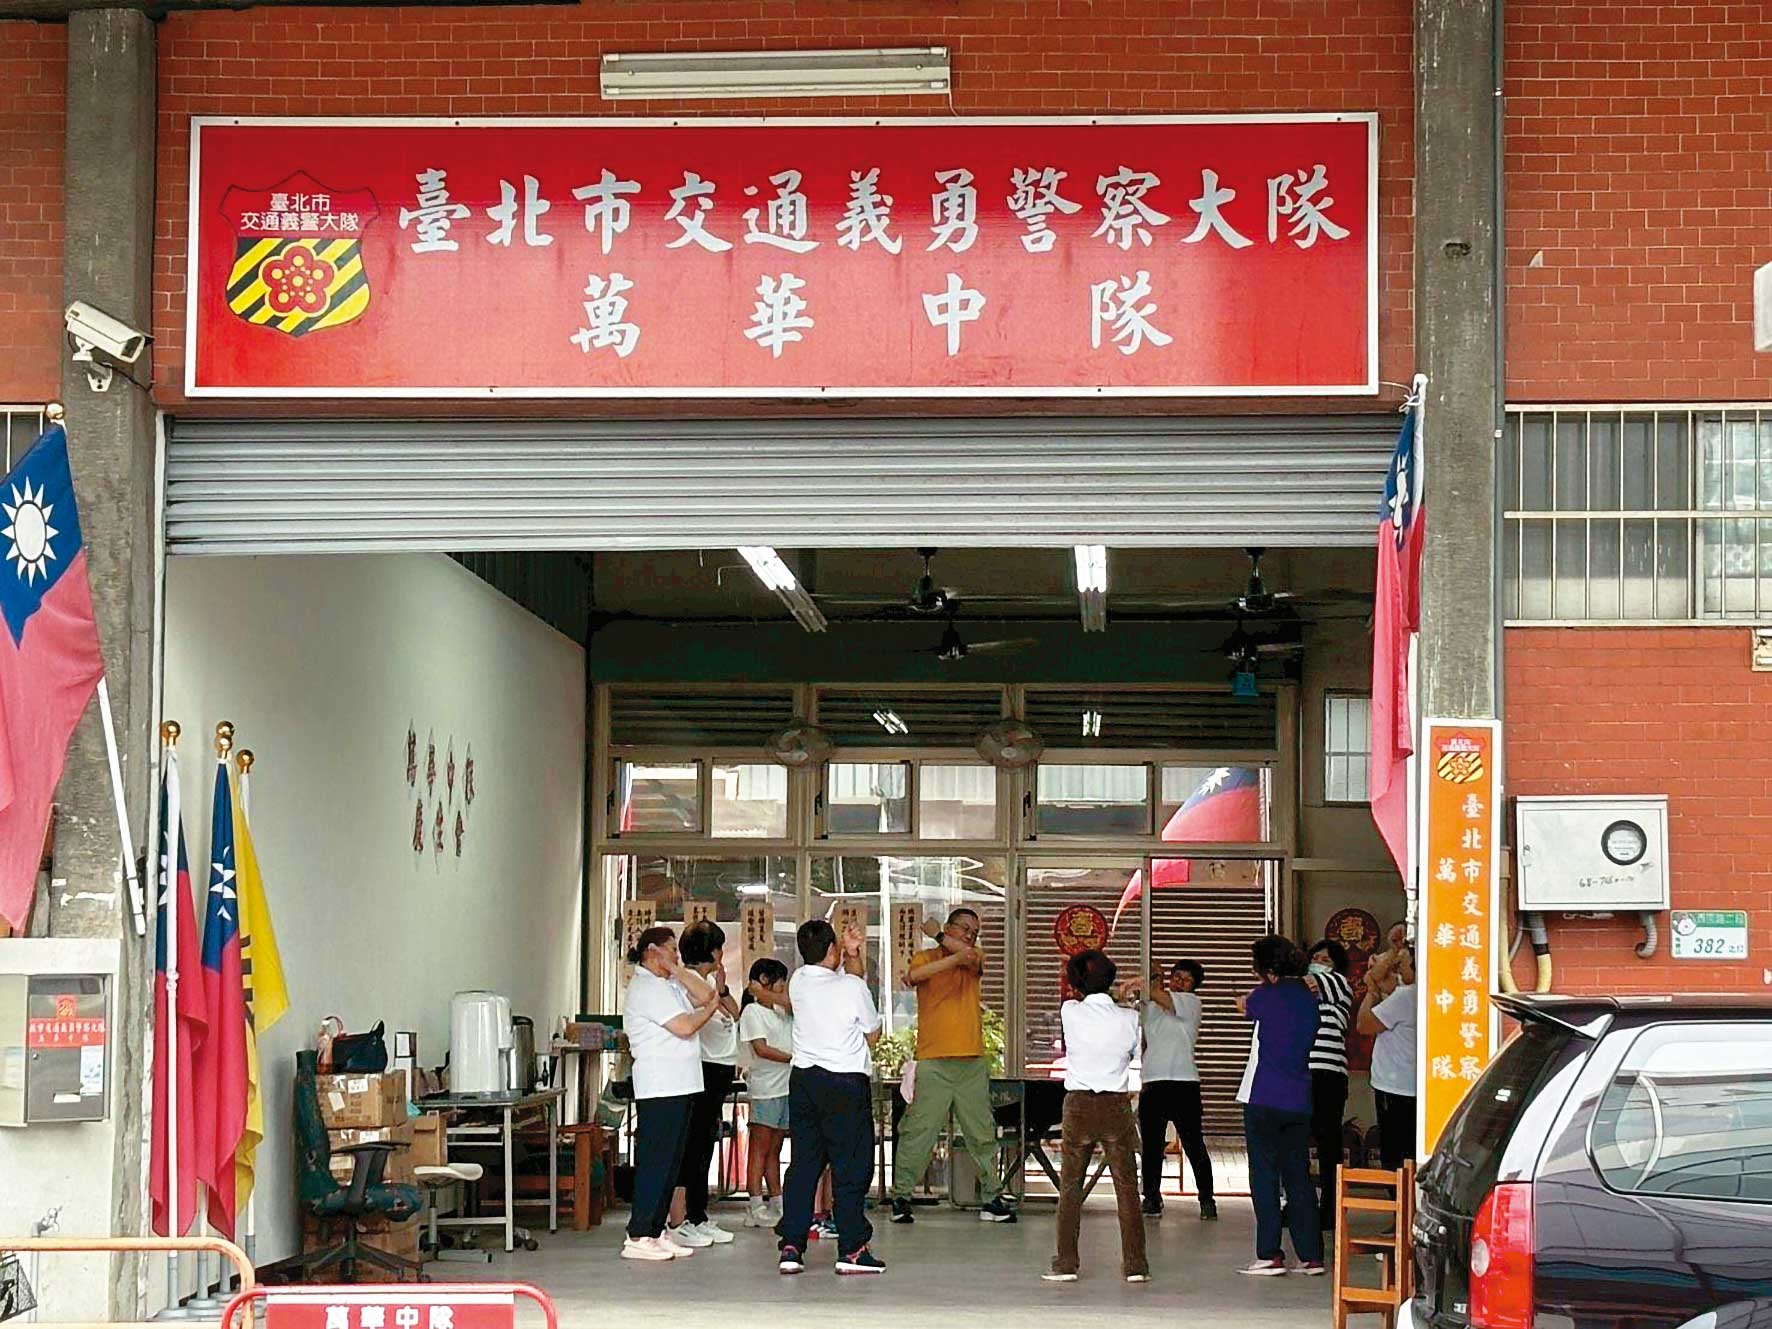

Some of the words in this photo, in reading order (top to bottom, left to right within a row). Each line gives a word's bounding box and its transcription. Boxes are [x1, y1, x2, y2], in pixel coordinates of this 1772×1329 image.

[240, 212, 359, 231] 交通義警大隊
[269, 193, 331, 212] 臺北市
[399, 164, 1350, 255] 臺北市交通義勇警察大隊
[570, 271, 1173, 358] 萬華中隊
[1458, 794, 1485, 1080] 臺北市交通義勇警察
[1694, 938, 1725, 954] 382
[1432, 857, 1457, 1080] 萬華中隊
[325, 1305, 455, 1329] 萬華中隊
